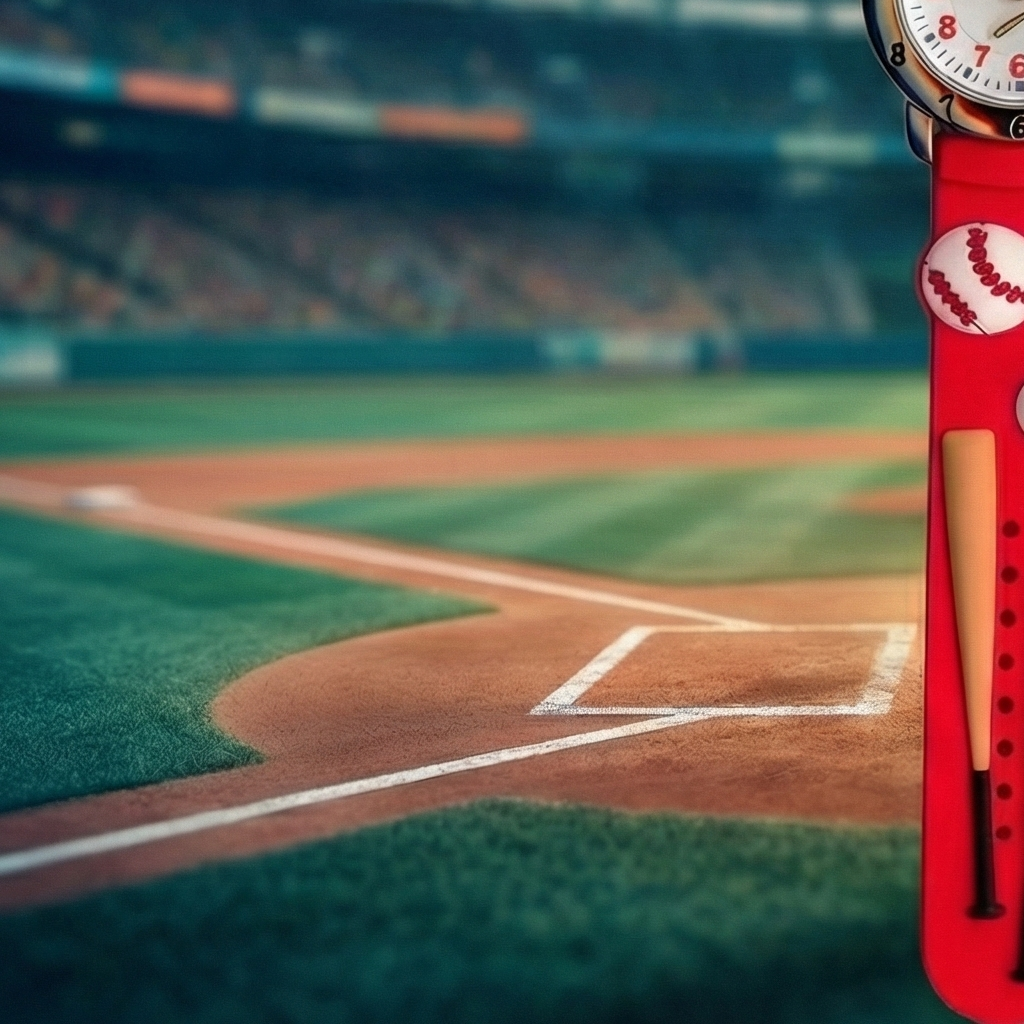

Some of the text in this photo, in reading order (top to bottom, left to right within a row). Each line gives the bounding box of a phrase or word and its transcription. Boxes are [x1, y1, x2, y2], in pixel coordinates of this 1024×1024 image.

[939, 15, 956, 39] 8
[890, 43, 906, 66] 8
[975, 45, 991, 67] 7
